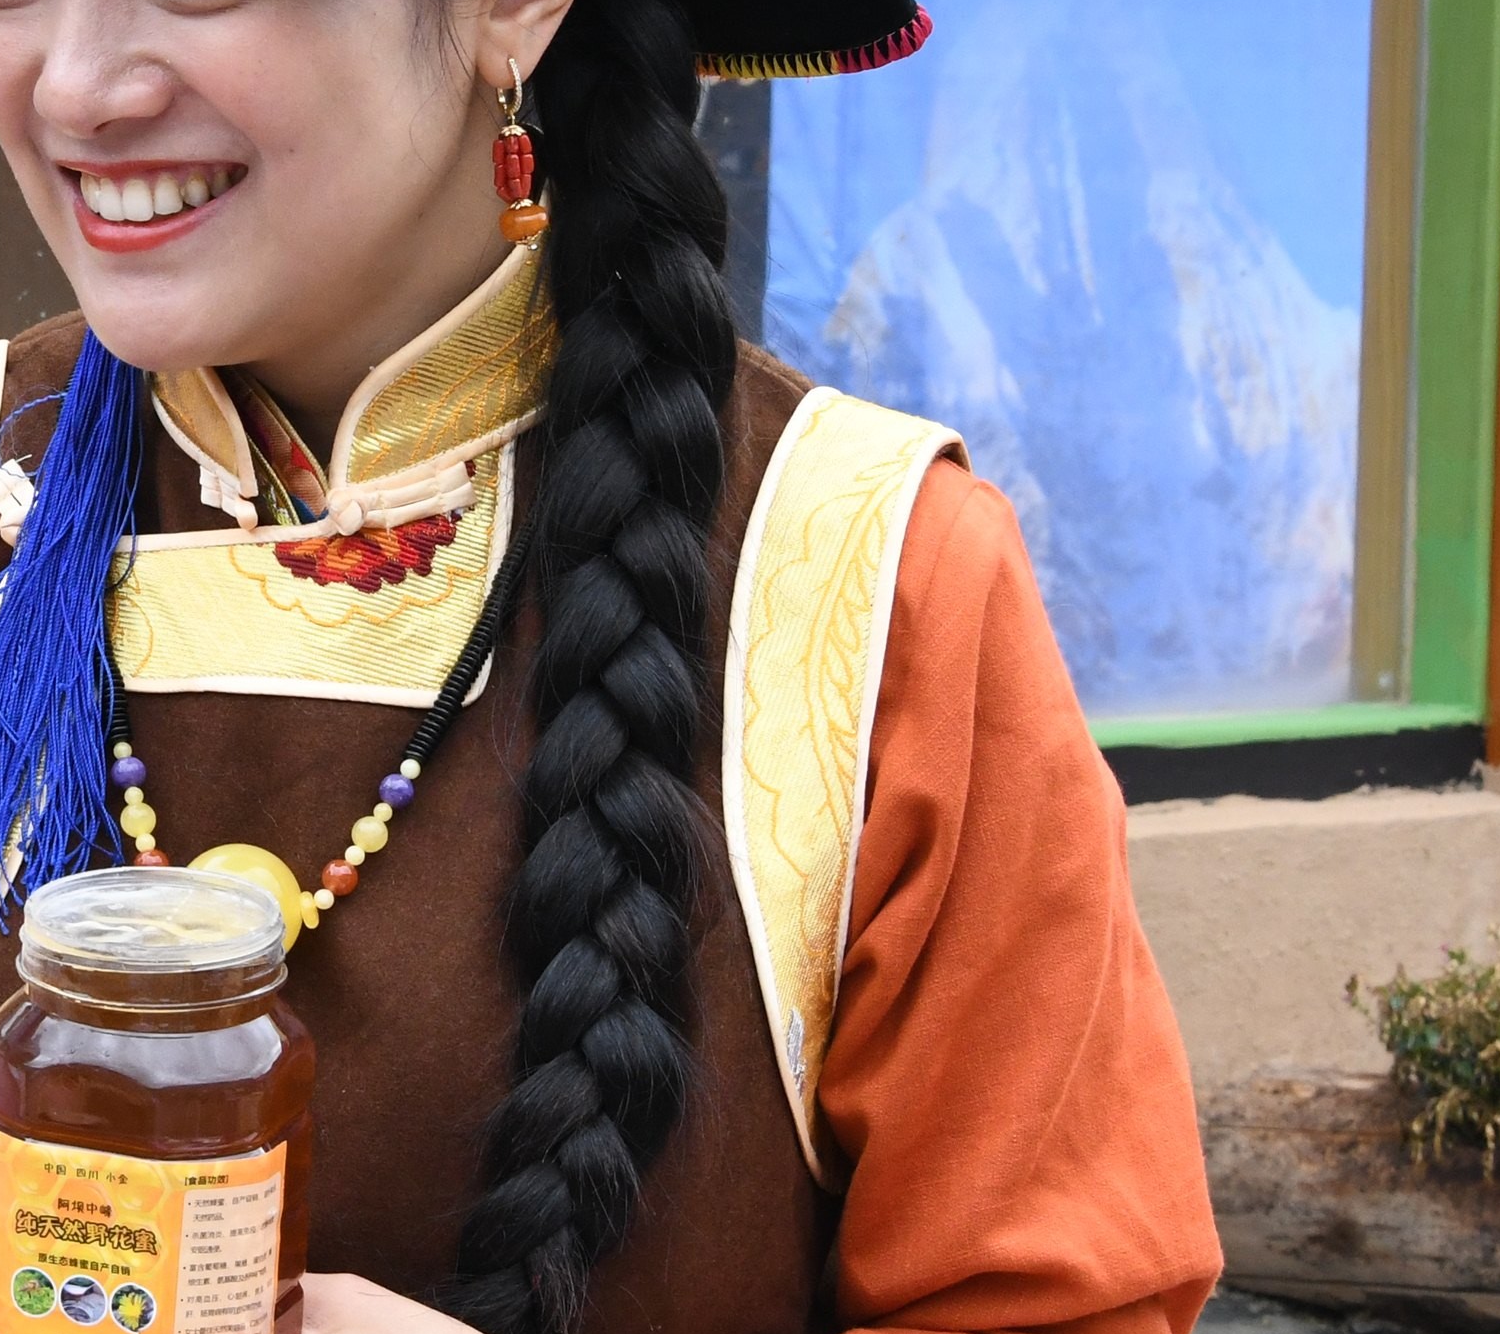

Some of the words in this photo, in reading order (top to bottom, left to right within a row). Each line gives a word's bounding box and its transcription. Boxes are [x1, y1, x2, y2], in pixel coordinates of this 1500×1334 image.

[44, 1163, 67, 1176] 中国
[76, 1168, 99, 1180] 四川
[106, 1172, 129, 1185] 小金
[15, 1208, 158, 1256] 纯天然野花蜜
[38, 1252, 131, 1277] 原生态蜂蜜自产自销
